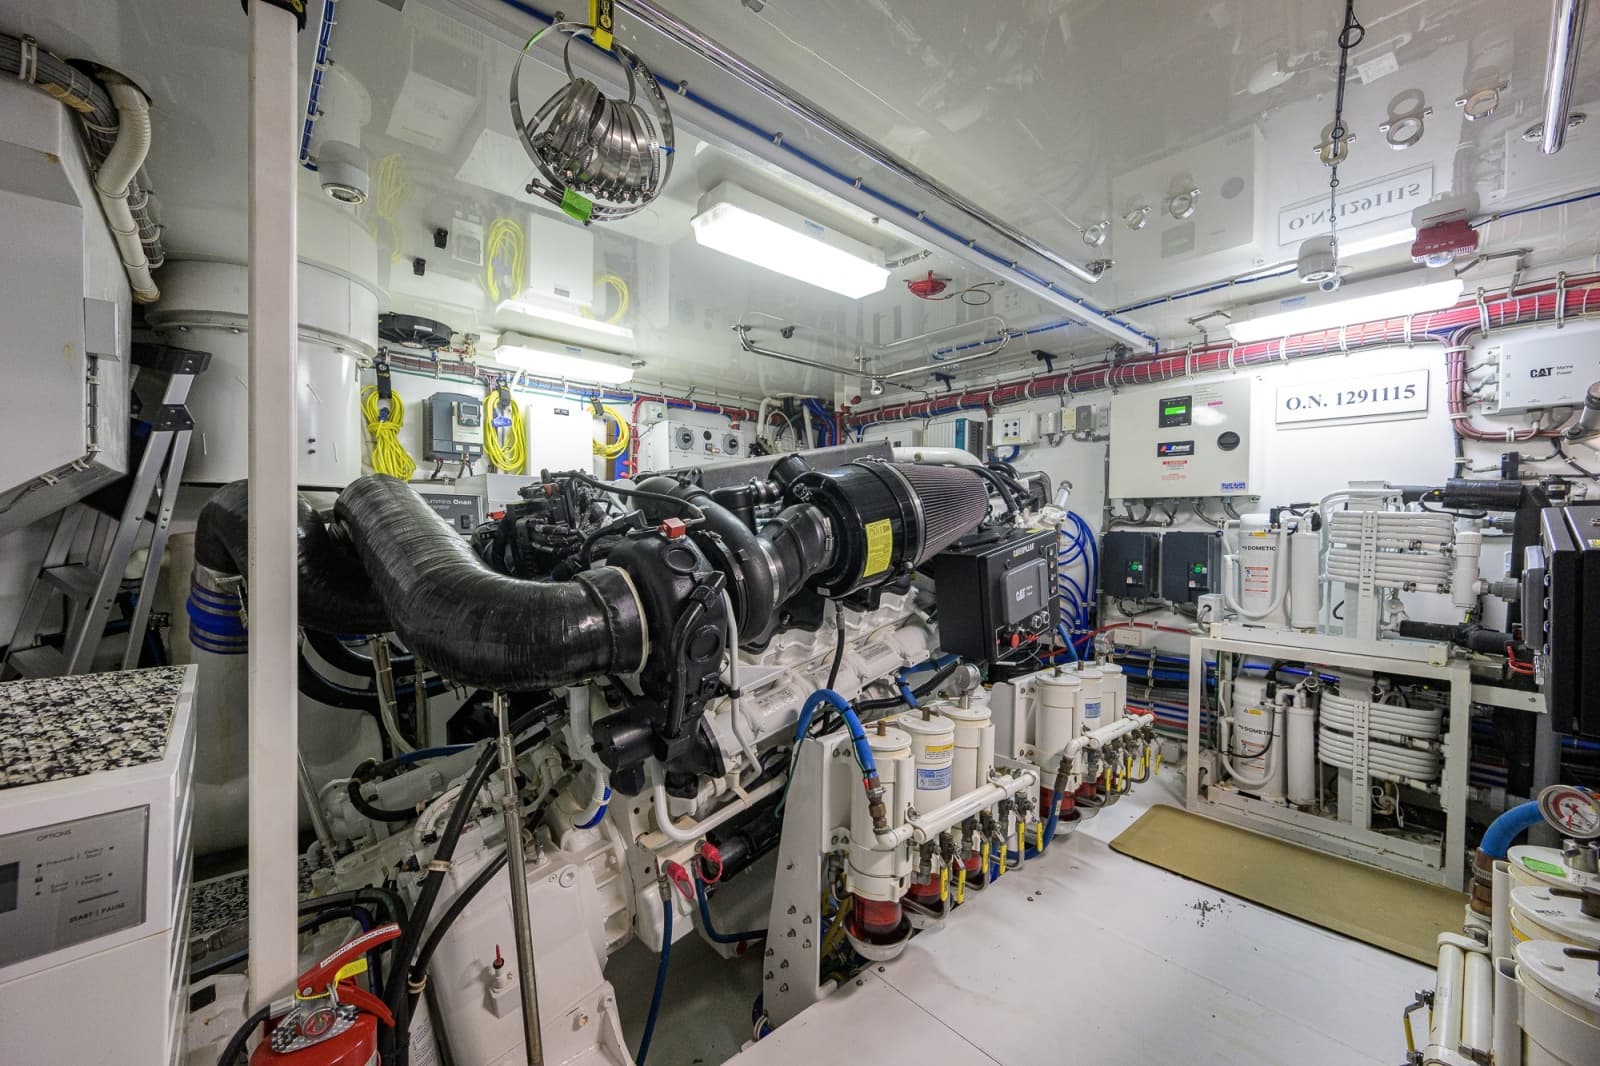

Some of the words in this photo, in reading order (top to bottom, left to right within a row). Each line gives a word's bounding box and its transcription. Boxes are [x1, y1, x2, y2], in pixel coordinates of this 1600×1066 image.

[1530, 367, 1553, 378] CAT
[1286, 394, 1328, 411] O.N.
[1336, 384, 1416, 406] 1291115
[36, 829, 72, 842] OPTIONS
[69, 911, 93, 923] START
[101, 902, 125, 914] PAUSE
